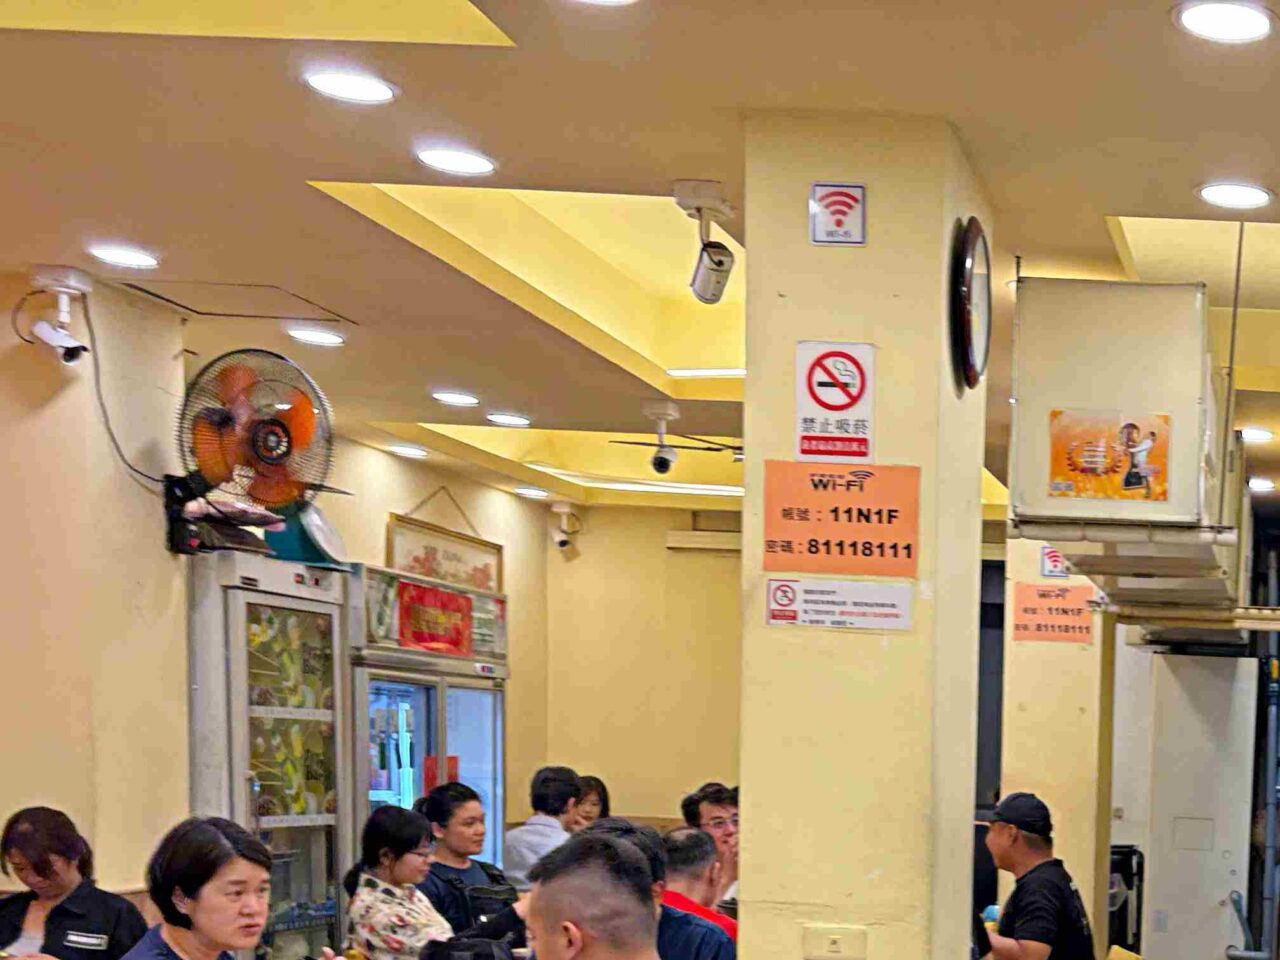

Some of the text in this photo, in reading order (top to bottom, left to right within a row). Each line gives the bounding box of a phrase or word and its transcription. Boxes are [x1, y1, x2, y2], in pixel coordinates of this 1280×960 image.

[811, 479, 864, 492] Wi-Fi
[829, 506, 899, 524] 11N1F
[808, 539, 914, 559] 81118111
